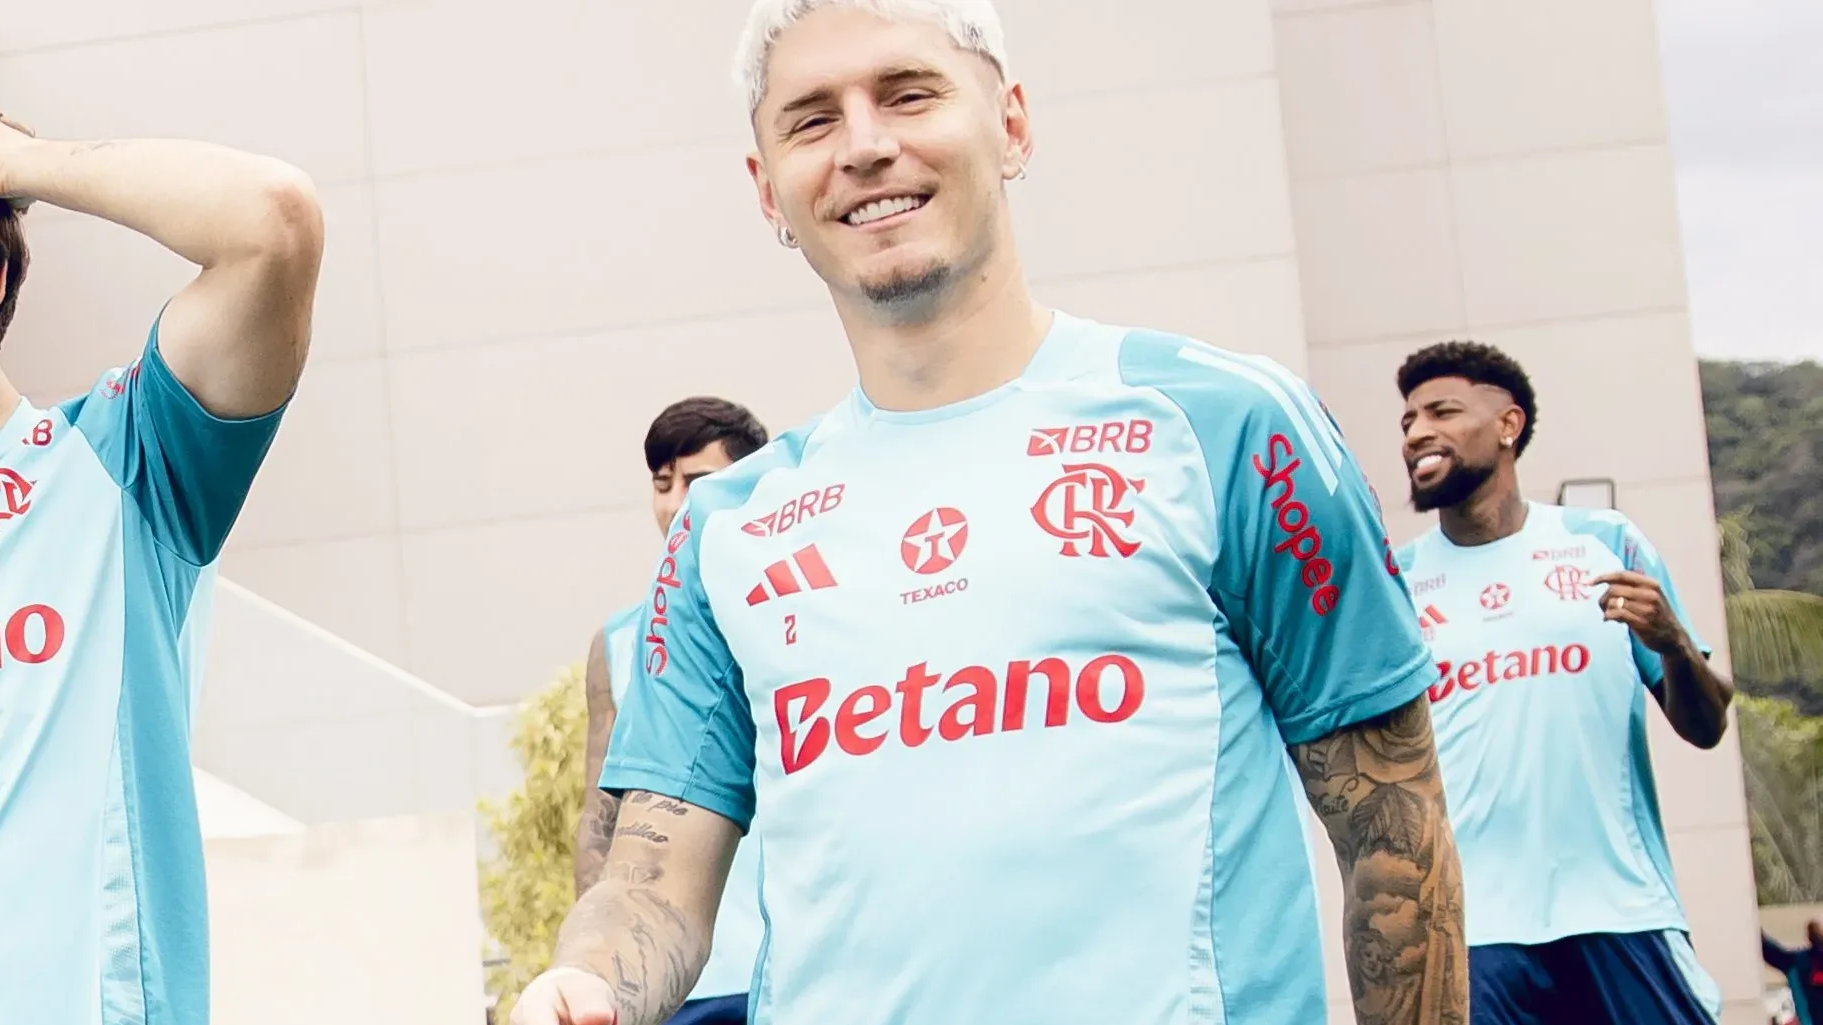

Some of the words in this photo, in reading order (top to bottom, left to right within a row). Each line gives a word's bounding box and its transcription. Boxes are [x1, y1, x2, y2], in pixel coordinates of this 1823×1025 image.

[1069, 419, 1153, 453] BRB
[777, 483, 845, 534] BRB
[1252, 432, 1340, 617] Shopee
[900, 578, 968, 604] TEXACO
[784, 614, 797, 645] 2
[774, 654, 1146, 775] Betano
